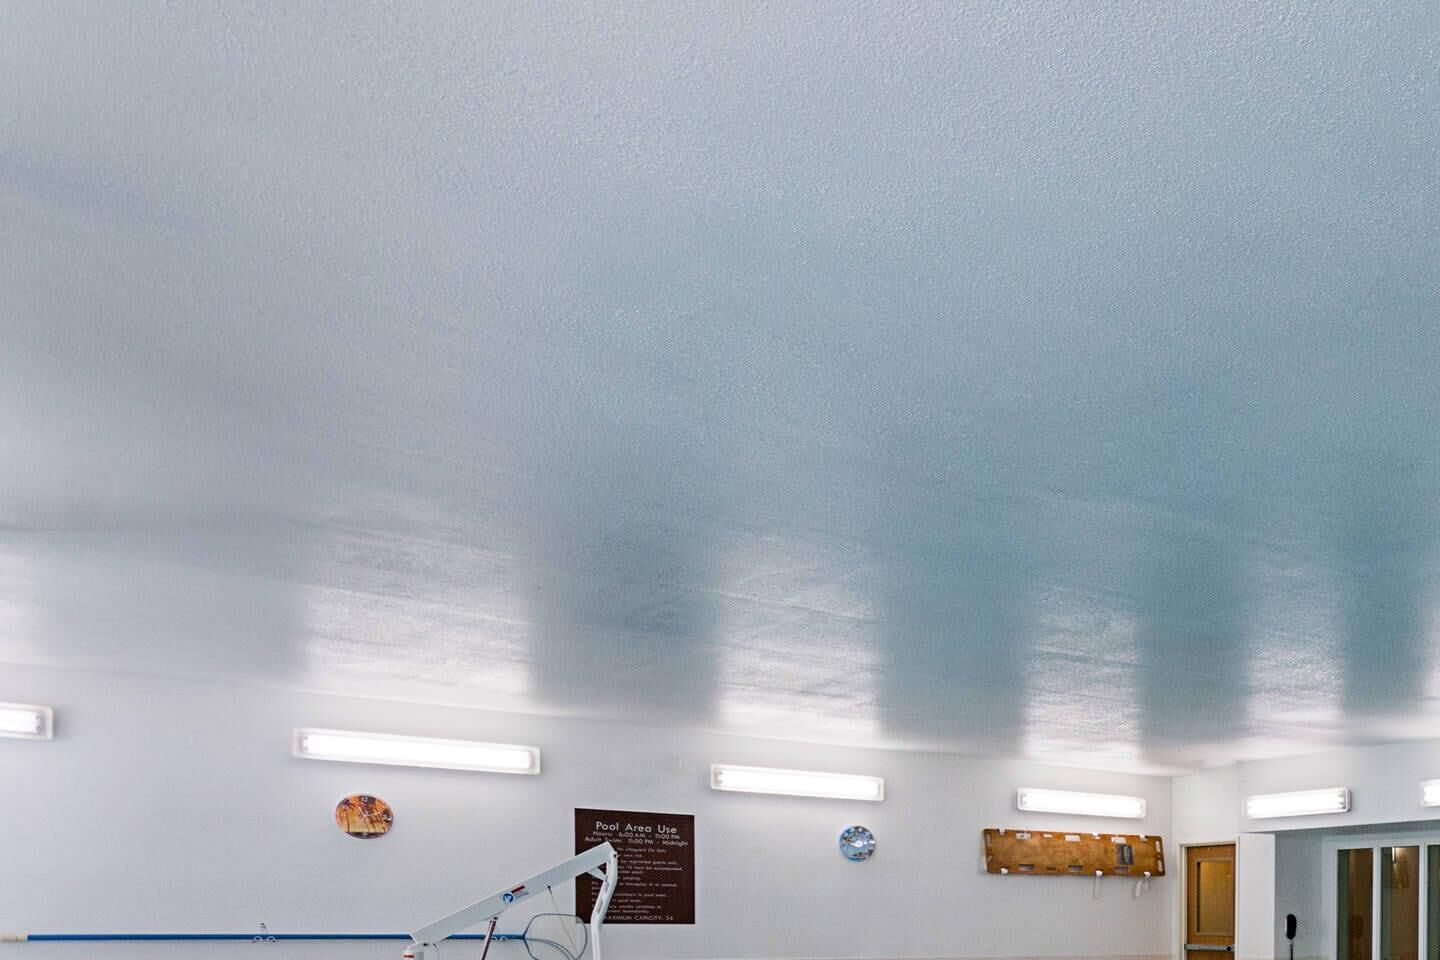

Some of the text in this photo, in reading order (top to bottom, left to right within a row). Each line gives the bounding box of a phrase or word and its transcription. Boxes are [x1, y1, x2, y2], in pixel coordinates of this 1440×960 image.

[596, 821, 678, 834] Pool Area Use
